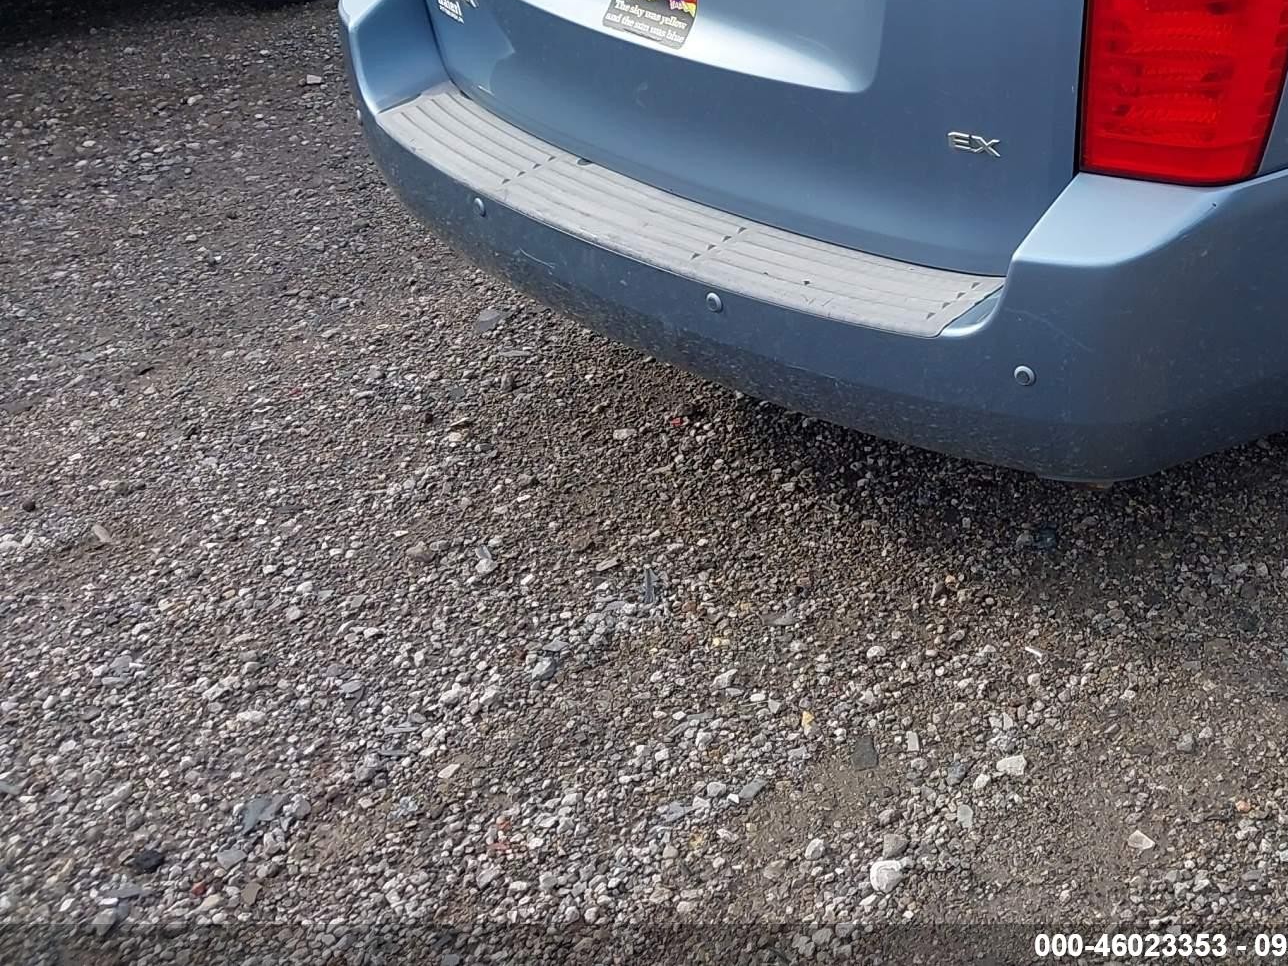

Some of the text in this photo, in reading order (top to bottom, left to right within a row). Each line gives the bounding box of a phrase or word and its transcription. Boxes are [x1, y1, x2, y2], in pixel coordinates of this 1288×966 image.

[604, 12, 685, 43] and the sun was blue
[614, 0, 689, 30] The sky was yellow
[947, 131, 1001, 157] EX
